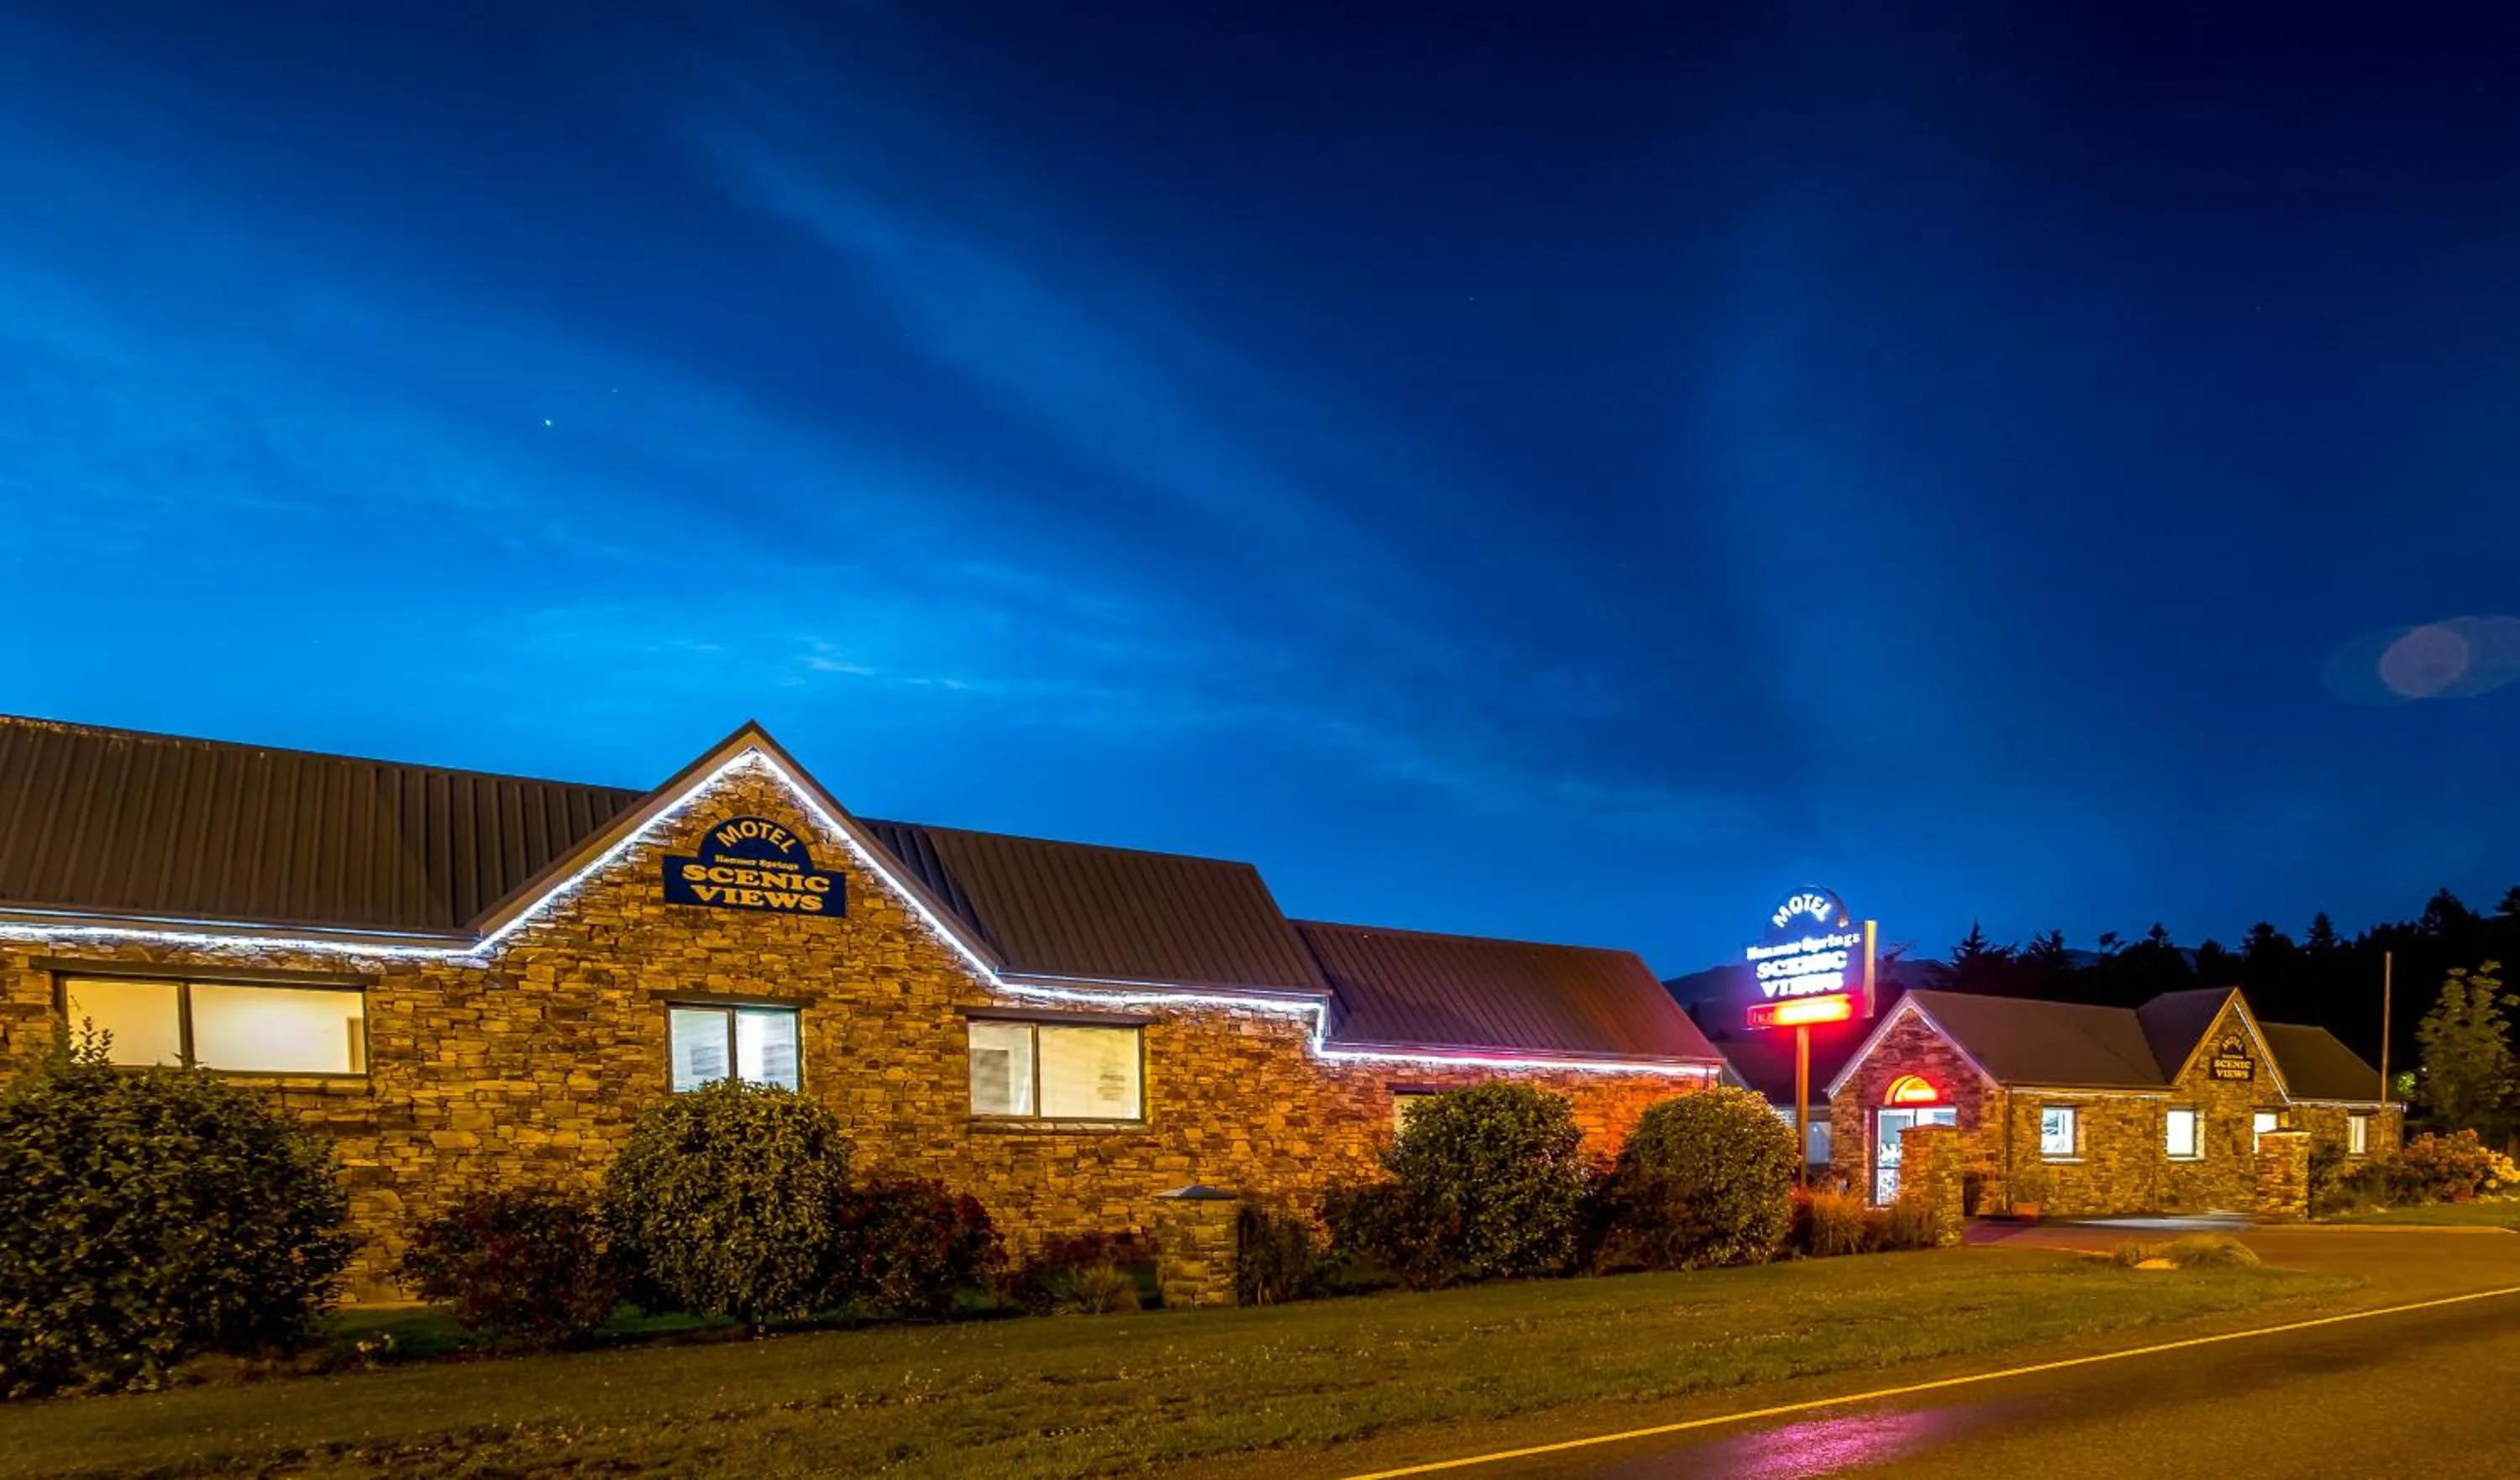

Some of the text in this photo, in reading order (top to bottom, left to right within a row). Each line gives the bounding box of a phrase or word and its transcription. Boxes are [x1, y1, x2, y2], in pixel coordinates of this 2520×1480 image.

[716, 821, 797, 854] MOTEL
[681, 864, 830, 893] SCENIC
[690, 884, 823, 911] VIEWS
[1772, 894, 1832, 927] MOTEL
[2214, 1059, 2252, 1069] SCENIC
[2216, 1068, 2249, 1079] VIEWS
